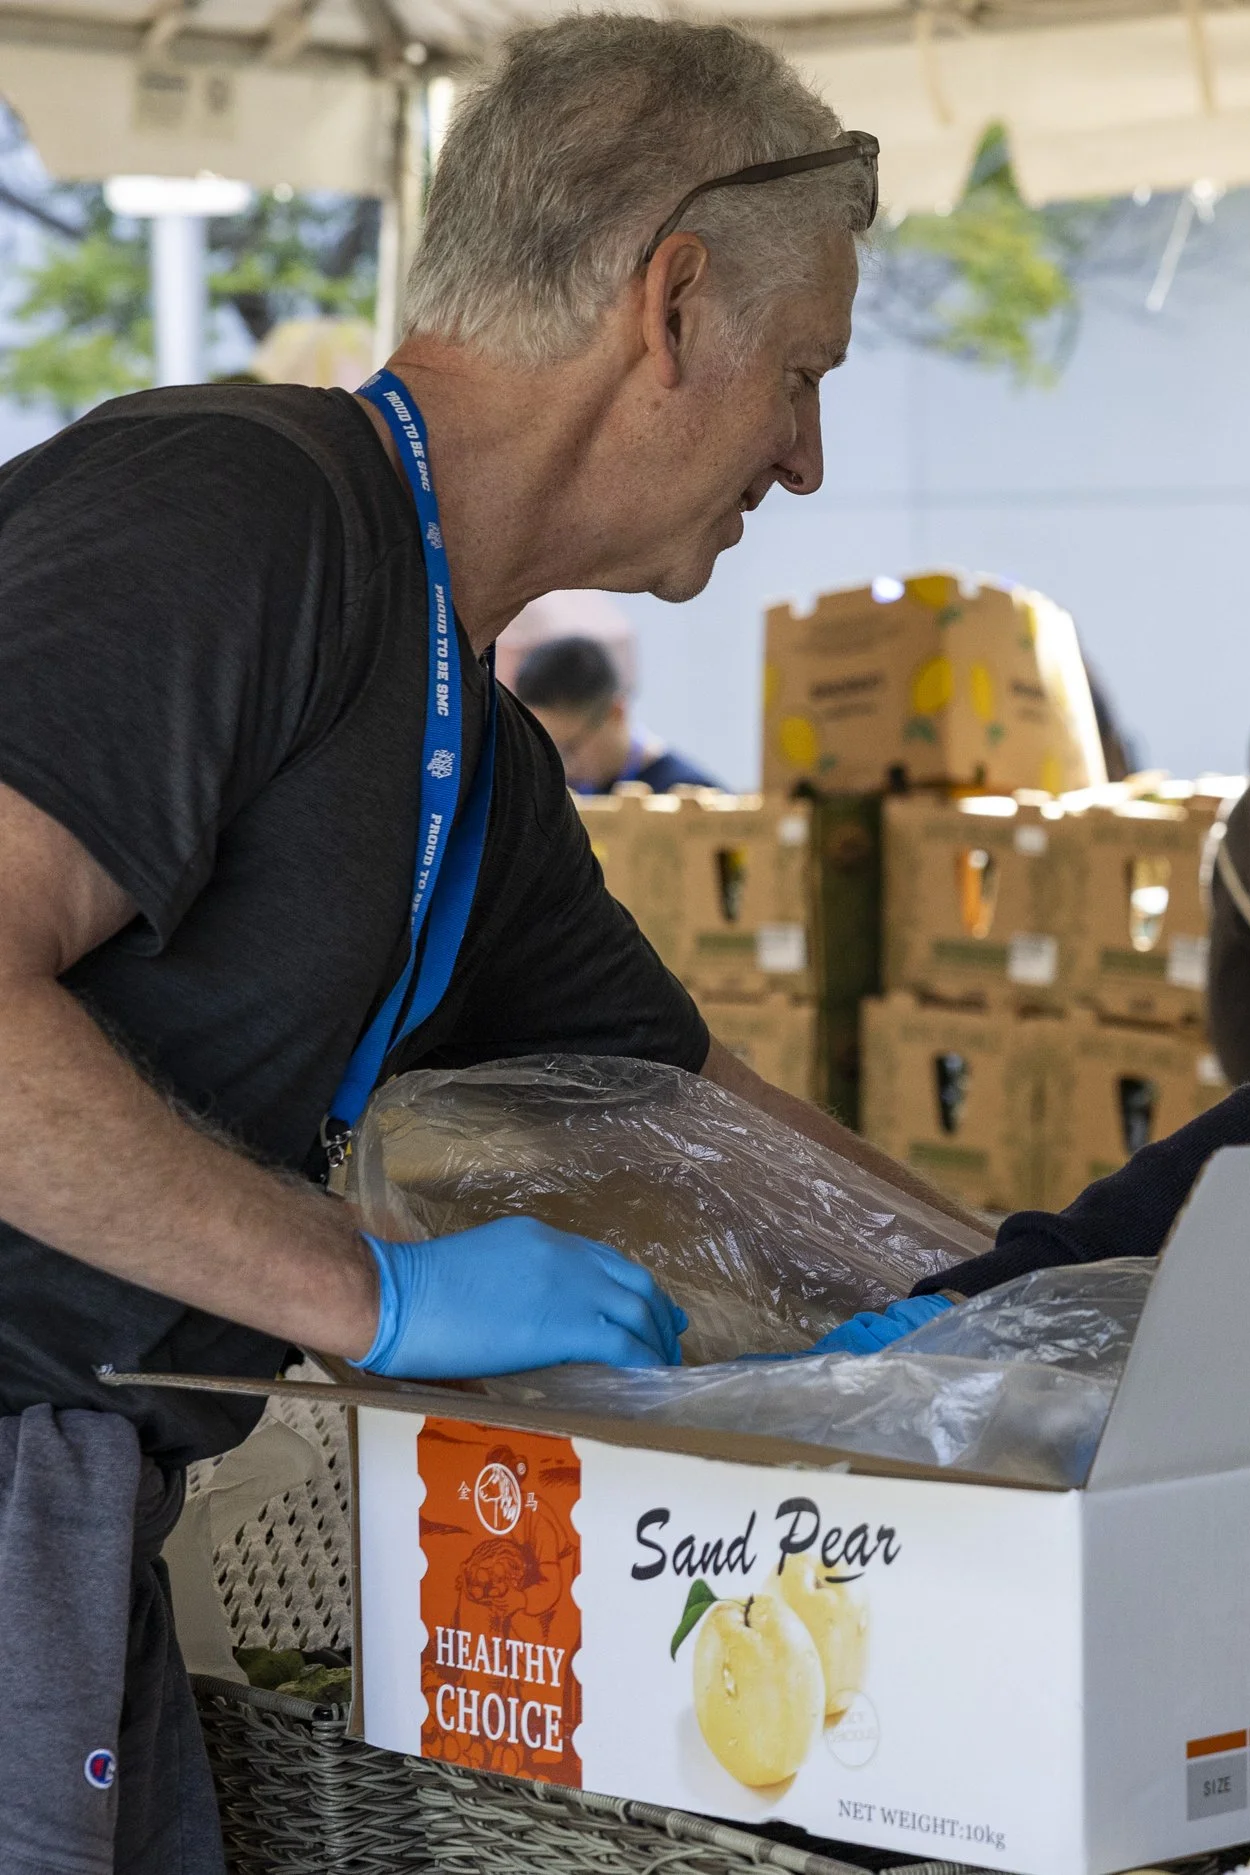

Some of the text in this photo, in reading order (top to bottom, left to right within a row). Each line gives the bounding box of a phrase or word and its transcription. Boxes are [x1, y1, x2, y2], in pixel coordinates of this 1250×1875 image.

[382, 390, 431, 492] PROUD TO BE SMC
[434, 583, 449, 716] PROUD TO BE SMC
[422, 813, 442, 866] PROUD
[418, 869, 430, 889] TO
[525, 1492, 538, 1512] 马
[631, 1496, 901, 1581] Sand Pear
[435, 1626, 566, 1687] HEALTHY
[435, 1684, 564, 1753] CHOICE
[1203, 1776, 1232, 1797] SIZE
[838, 1798, 1006, 1851] NET WEIGHT:10kg
